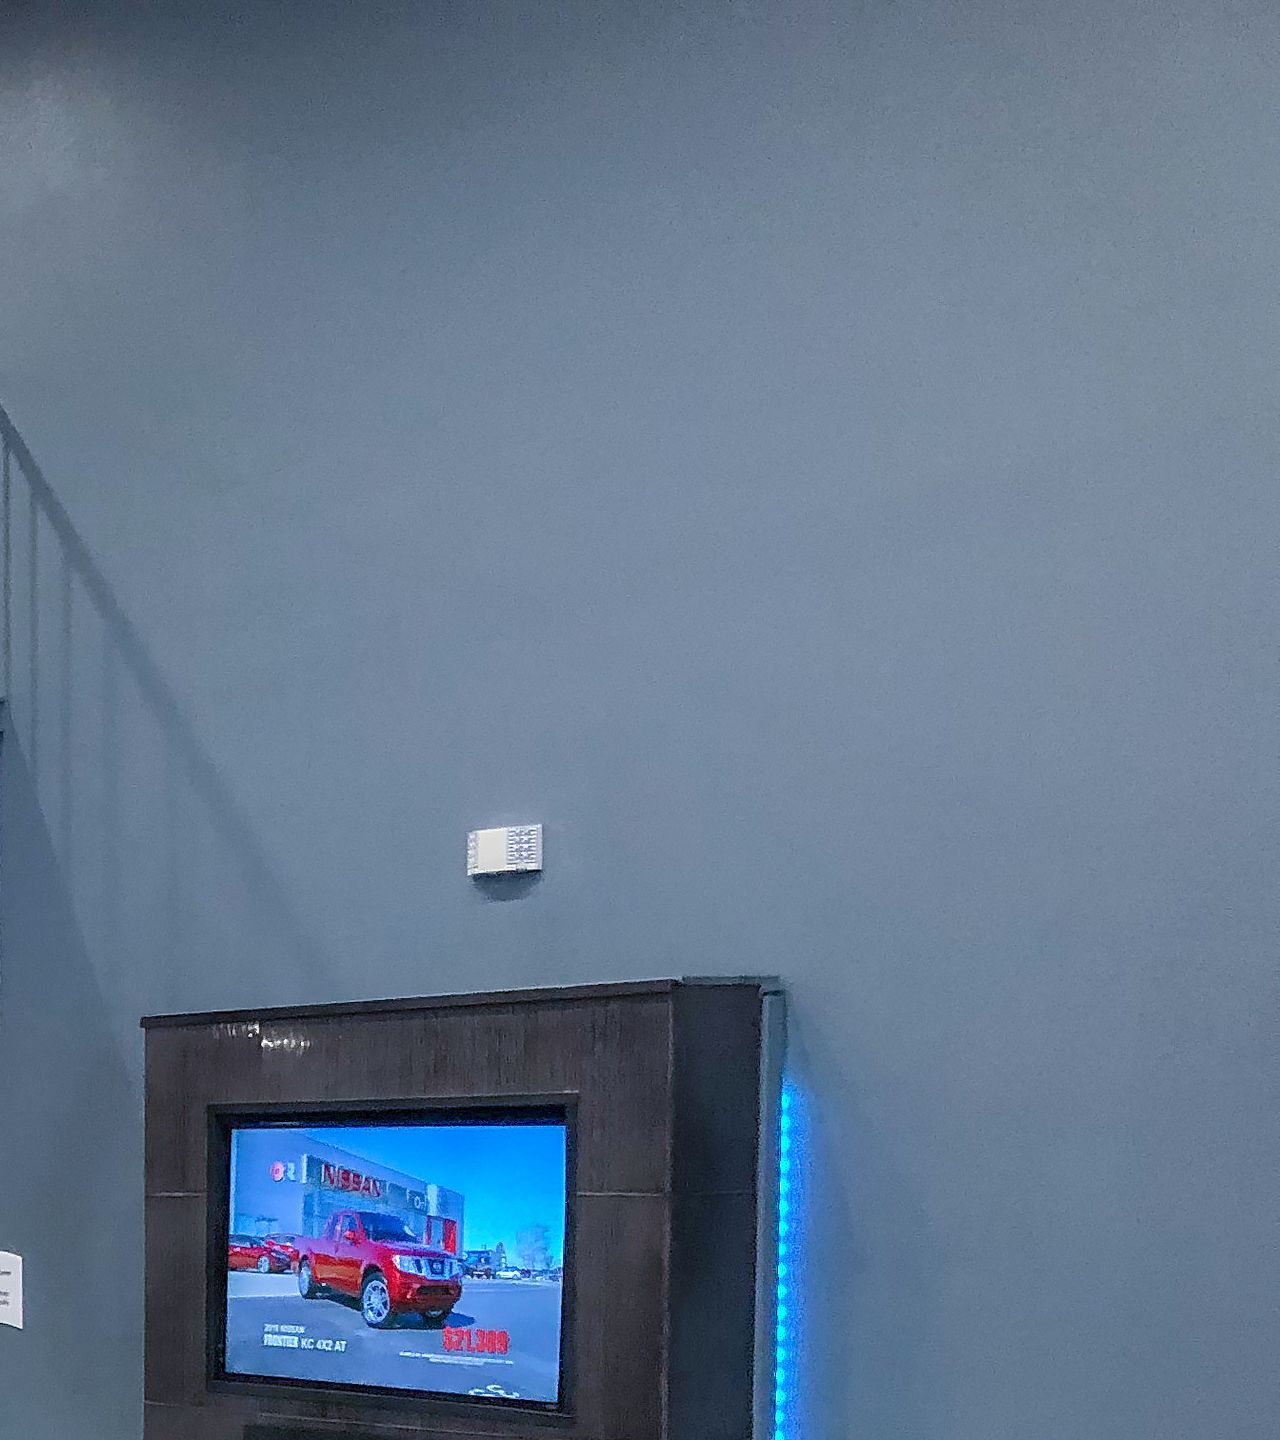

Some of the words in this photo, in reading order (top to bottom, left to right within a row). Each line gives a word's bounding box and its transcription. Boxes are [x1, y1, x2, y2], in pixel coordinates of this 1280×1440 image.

[322, 1162, 382, 1198] NISSAN
[300, 1338, 315, 1350] KC
[333, 1340, 347, 1353] AT
